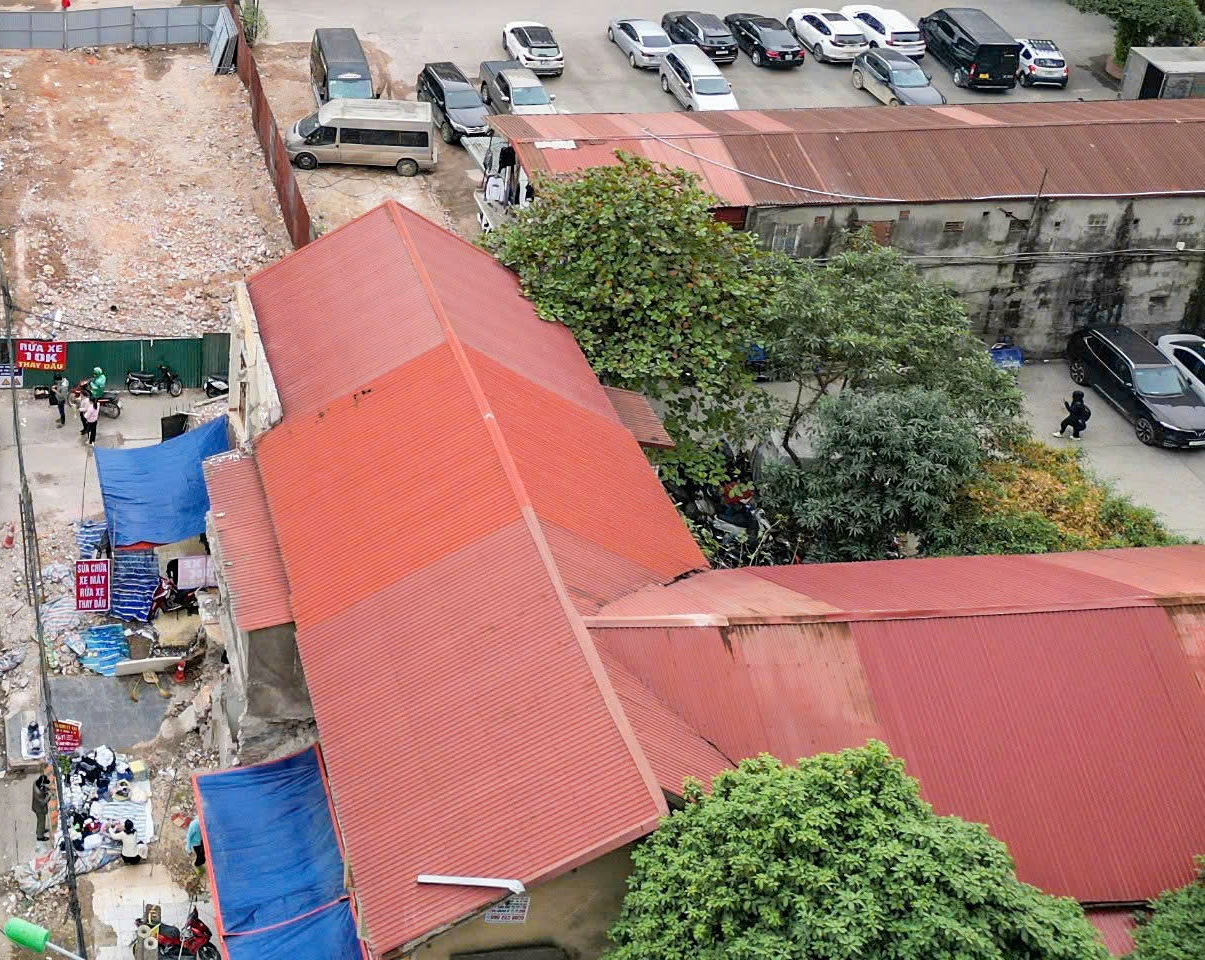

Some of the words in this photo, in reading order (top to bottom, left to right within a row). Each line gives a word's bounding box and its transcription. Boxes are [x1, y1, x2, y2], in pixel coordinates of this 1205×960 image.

[47, 344, 63, 352] XE
[24, 352, 57, 363] 10K
[18, 361, 42, 369] THAY
[79, 576, 88, 585] XE
[89, 575, 105, 585] MÁY
[95, 588, 104, 596] XE
[78, 600, 92, 609] THAY
